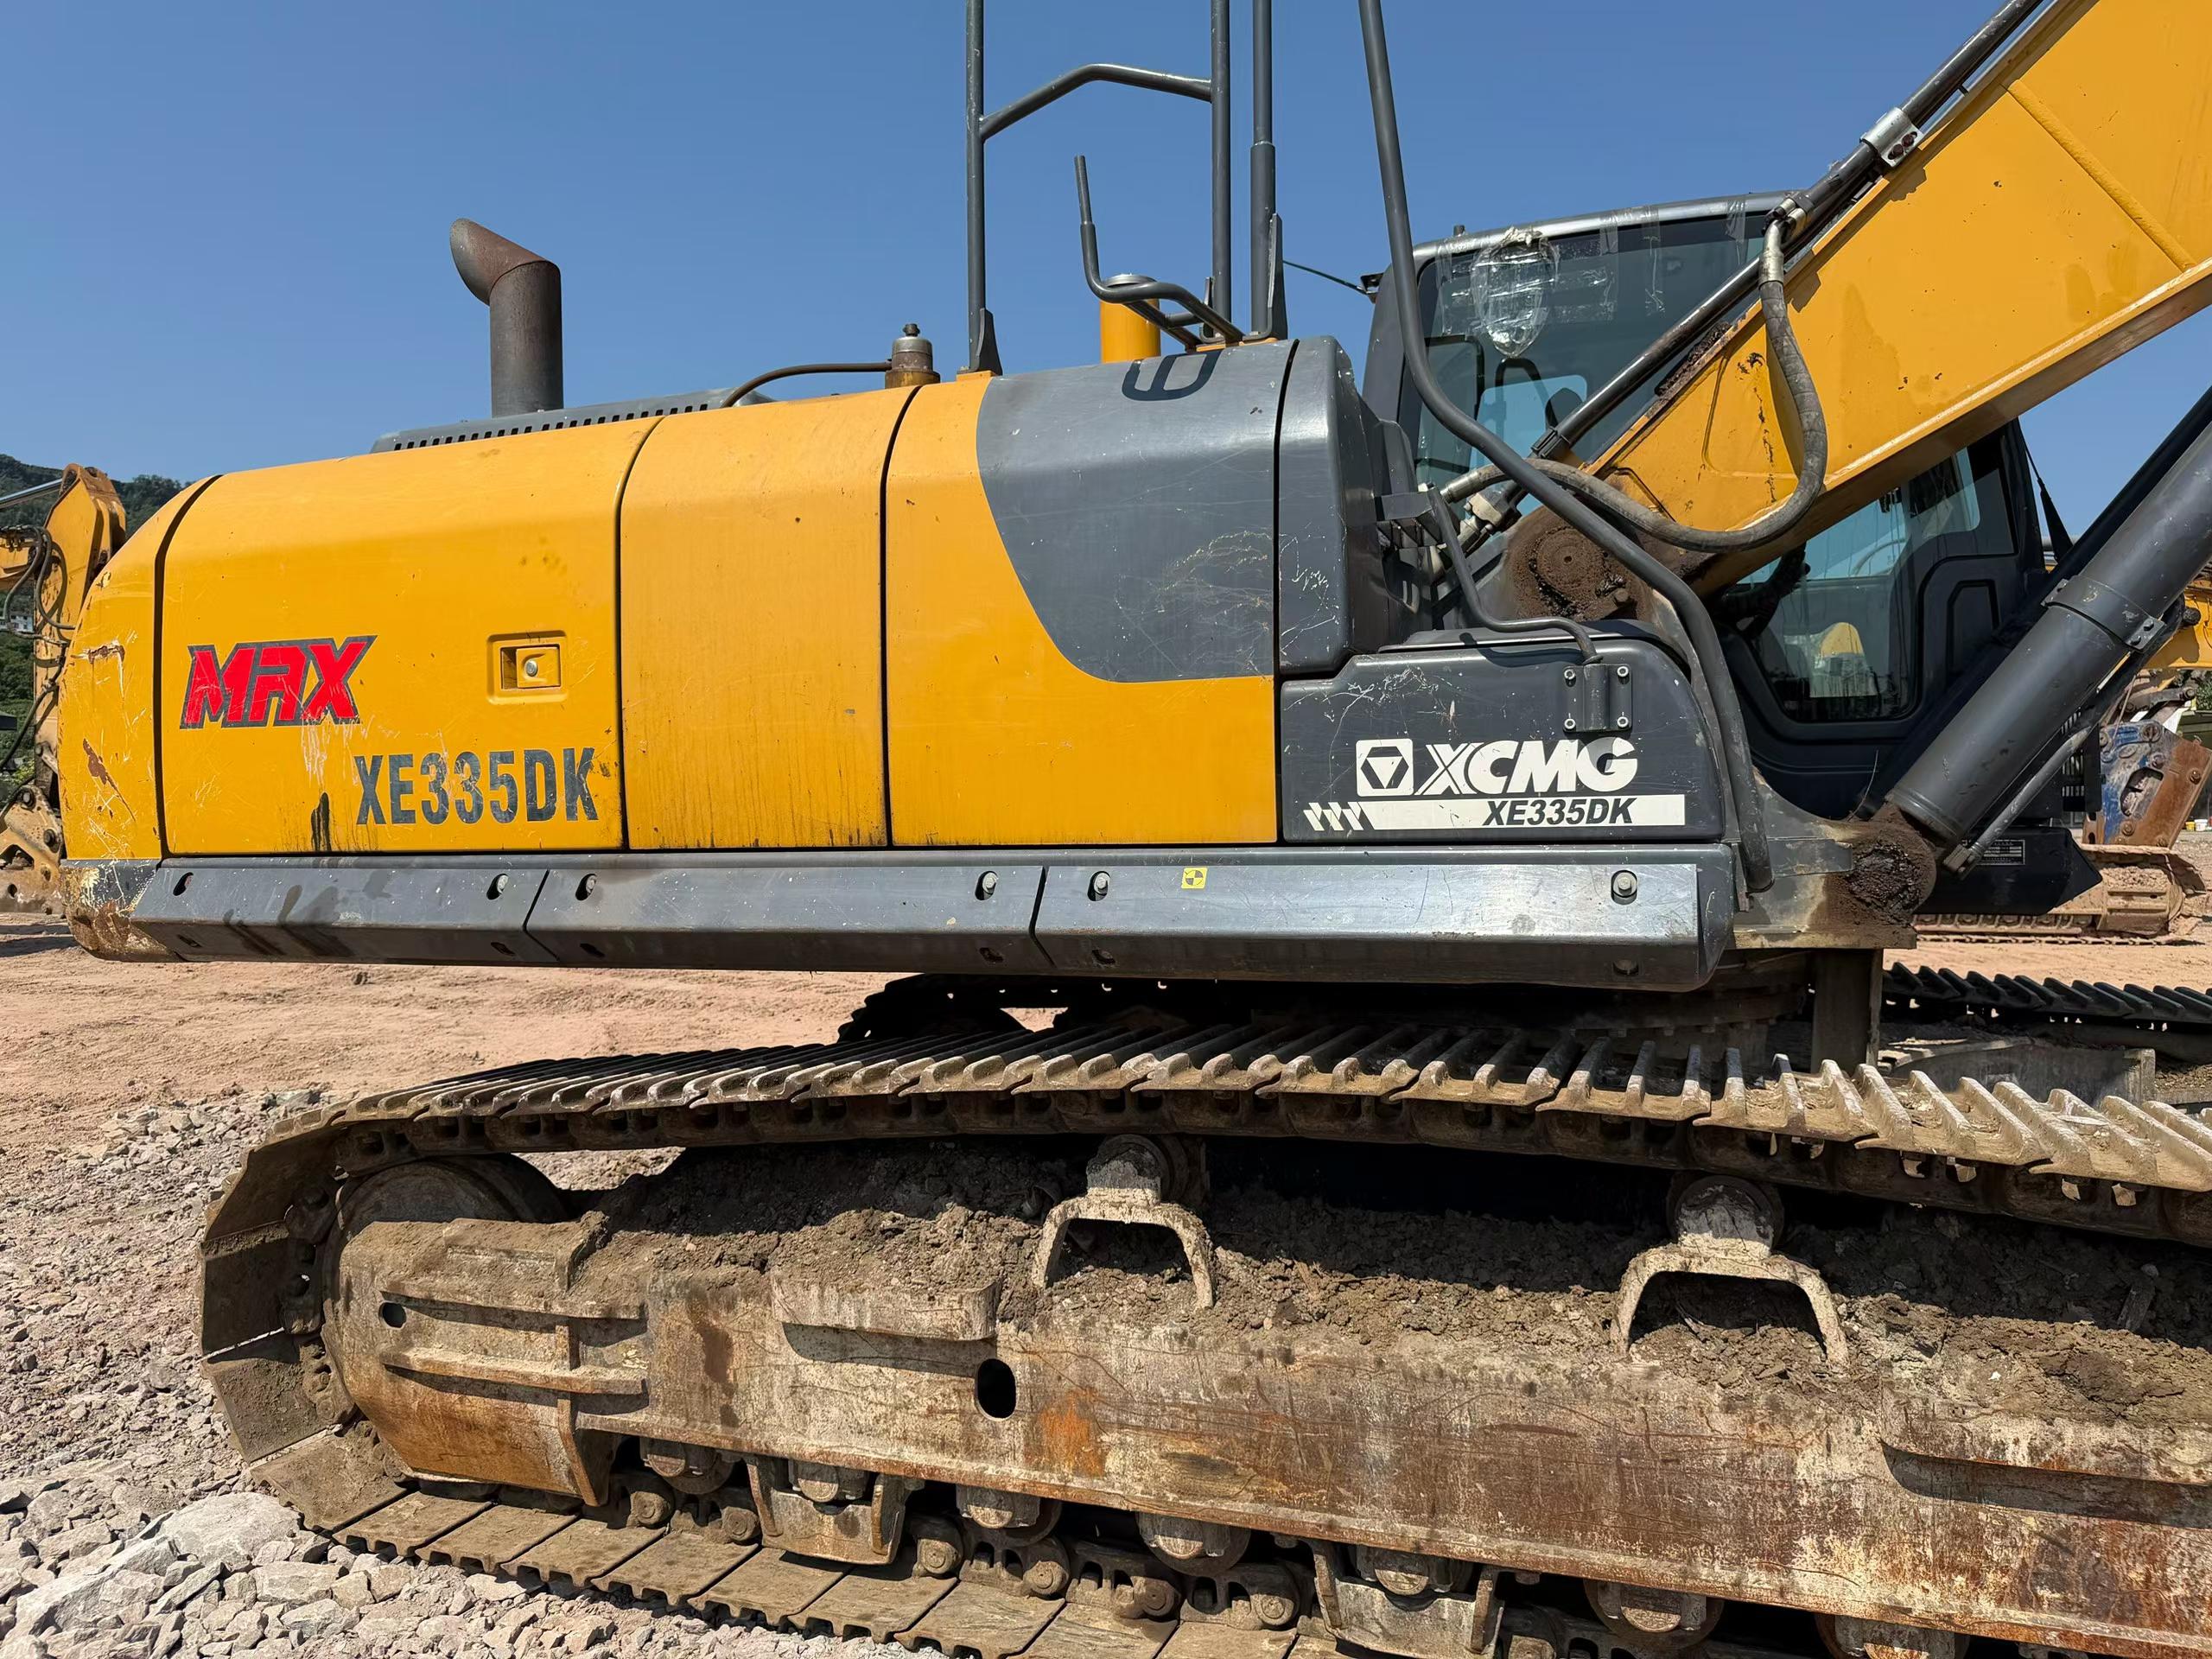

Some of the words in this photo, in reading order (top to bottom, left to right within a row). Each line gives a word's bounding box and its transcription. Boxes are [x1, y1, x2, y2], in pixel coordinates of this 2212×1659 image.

[180, 635, 378, 729] MAX
[353, 747, 599, 824] XE335DK
[1414, 736, 1638, 796] XCMG
[1483, 798, 1637, 826] XE335DK
